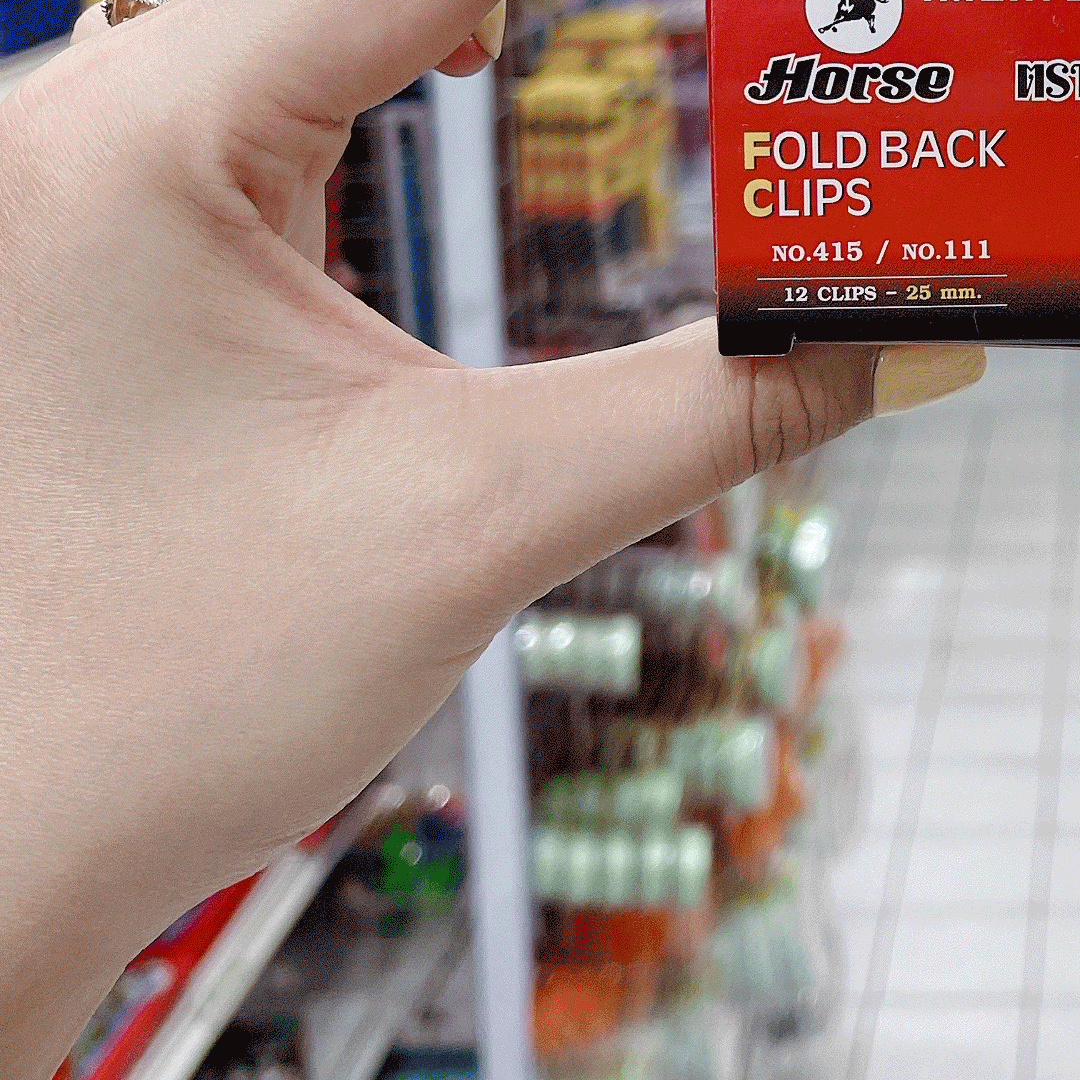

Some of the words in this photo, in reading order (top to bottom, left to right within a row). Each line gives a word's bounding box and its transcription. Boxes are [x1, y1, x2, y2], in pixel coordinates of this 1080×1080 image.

[744, 52, 955, 105] Horse
[743, 131, 868, 170] FOLD
[880, 129, 1007, 169] BACK
[743, 177, 872, 218] CLIPS
[772, 240, 863, 262] NO.415
[875, 239, 890, 265] /
[901, 239, 991, 260] NO.111
[784, 286, 808, 302] 12
[817, 285, 877, 302] CLIPS
[905, 284, 932, 300] 25
[940, 286, 982, 300] mm.
